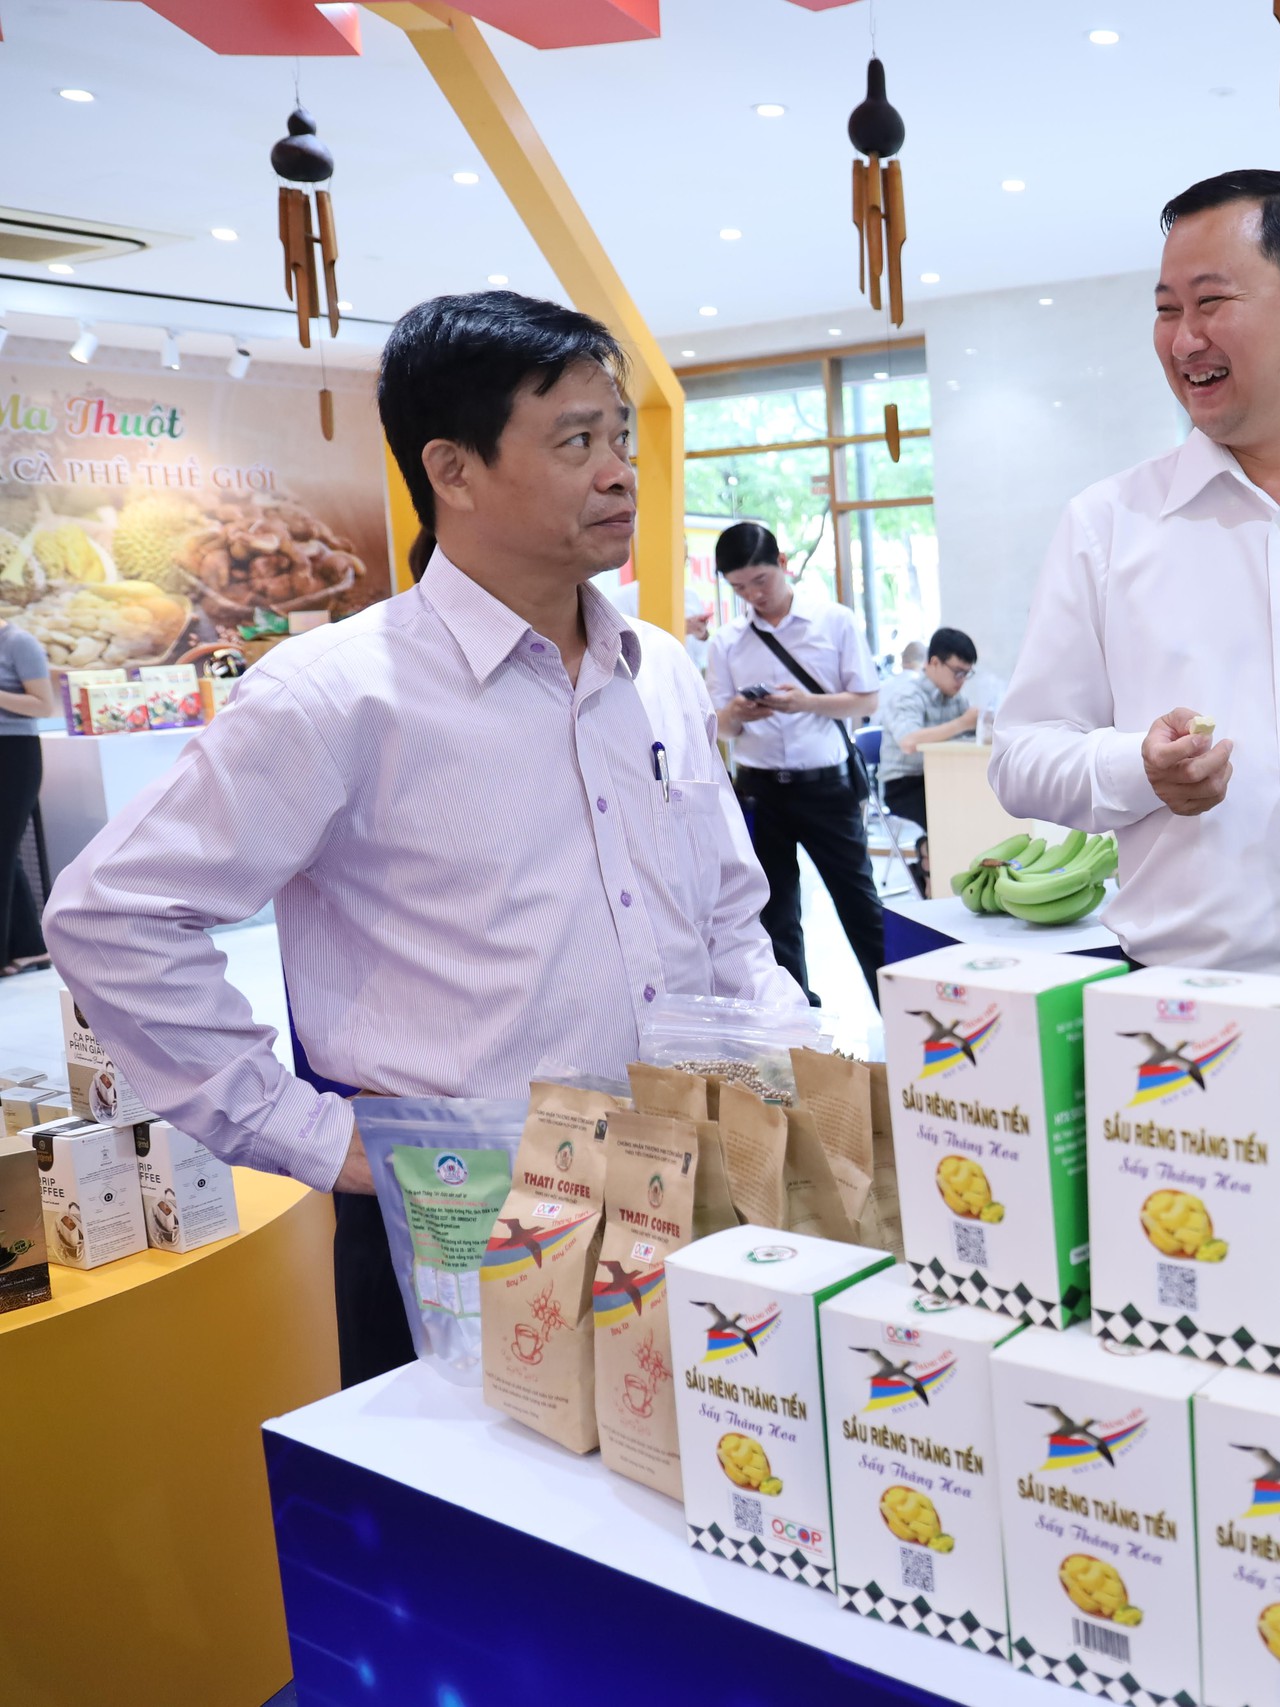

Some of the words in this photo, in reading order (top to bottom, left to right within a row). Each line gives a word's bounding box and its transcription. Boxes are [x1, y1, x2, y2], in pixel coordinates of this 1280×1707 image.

[66, 398, 185, 447] Thuột
[12, 452, 57, 482] CÀ
[66, 455, 129, 486] PHÊ
[145, 457, 201, 487] THẾ
[212, 465, 277, 491] GIỚI
[69, 1040, 88, 1052] PHIN
[925, 1092, 958, 1122] RIÊNG
[1001, 1105, 1031, 1136] TIẾN
[917, 1124, 938, 1146] Sấy
[988, 1140, 1020, 1161] Hoa
[1135, 1118, 1178, 1152] RIÊNG
[1233, 1132, 1268, 1165] TIẾN
[39, 1177, 56, 1186] RIP
[524, 1172, 555, 1190] THATI
[557, 1179, 591, 1199] COFFEE
[1119, 1156, 1149, 1179] Sấy
[1213, 1172, 1252, 1194] Hoa
[619, 1208, 649, 1228] THATI
[651, 1217, 681, 1239] COFFEE
[887, 1326, 919, 1344] OCOP
[708, 1375, 739, 1403] RIÊNG
[780, 1392, 807, 1422] TIẾN
[699, 1403, 720, 1422] Sấy
[768, 1423, 797, 1443] Hoa
[870, 1425, 908, 1455] RIÊNG
[954, 1445, 984, 1476] TIẾN
[859, 1454, 885, 1475] Sấy
[939, 1477, 972, 1499] Hoa
[771, 1518, 822, 1546] OCOP
[1048, 1484, 1089, 1517] RIÊNG
[1144, 1509, 1178, 1543] TIẾN
[1034, 1514, 1064, 1539] Sấy
[1126, 1540, 1163, 1565] Hoa
[1233, 1564, 1267, 1591] Sấy
